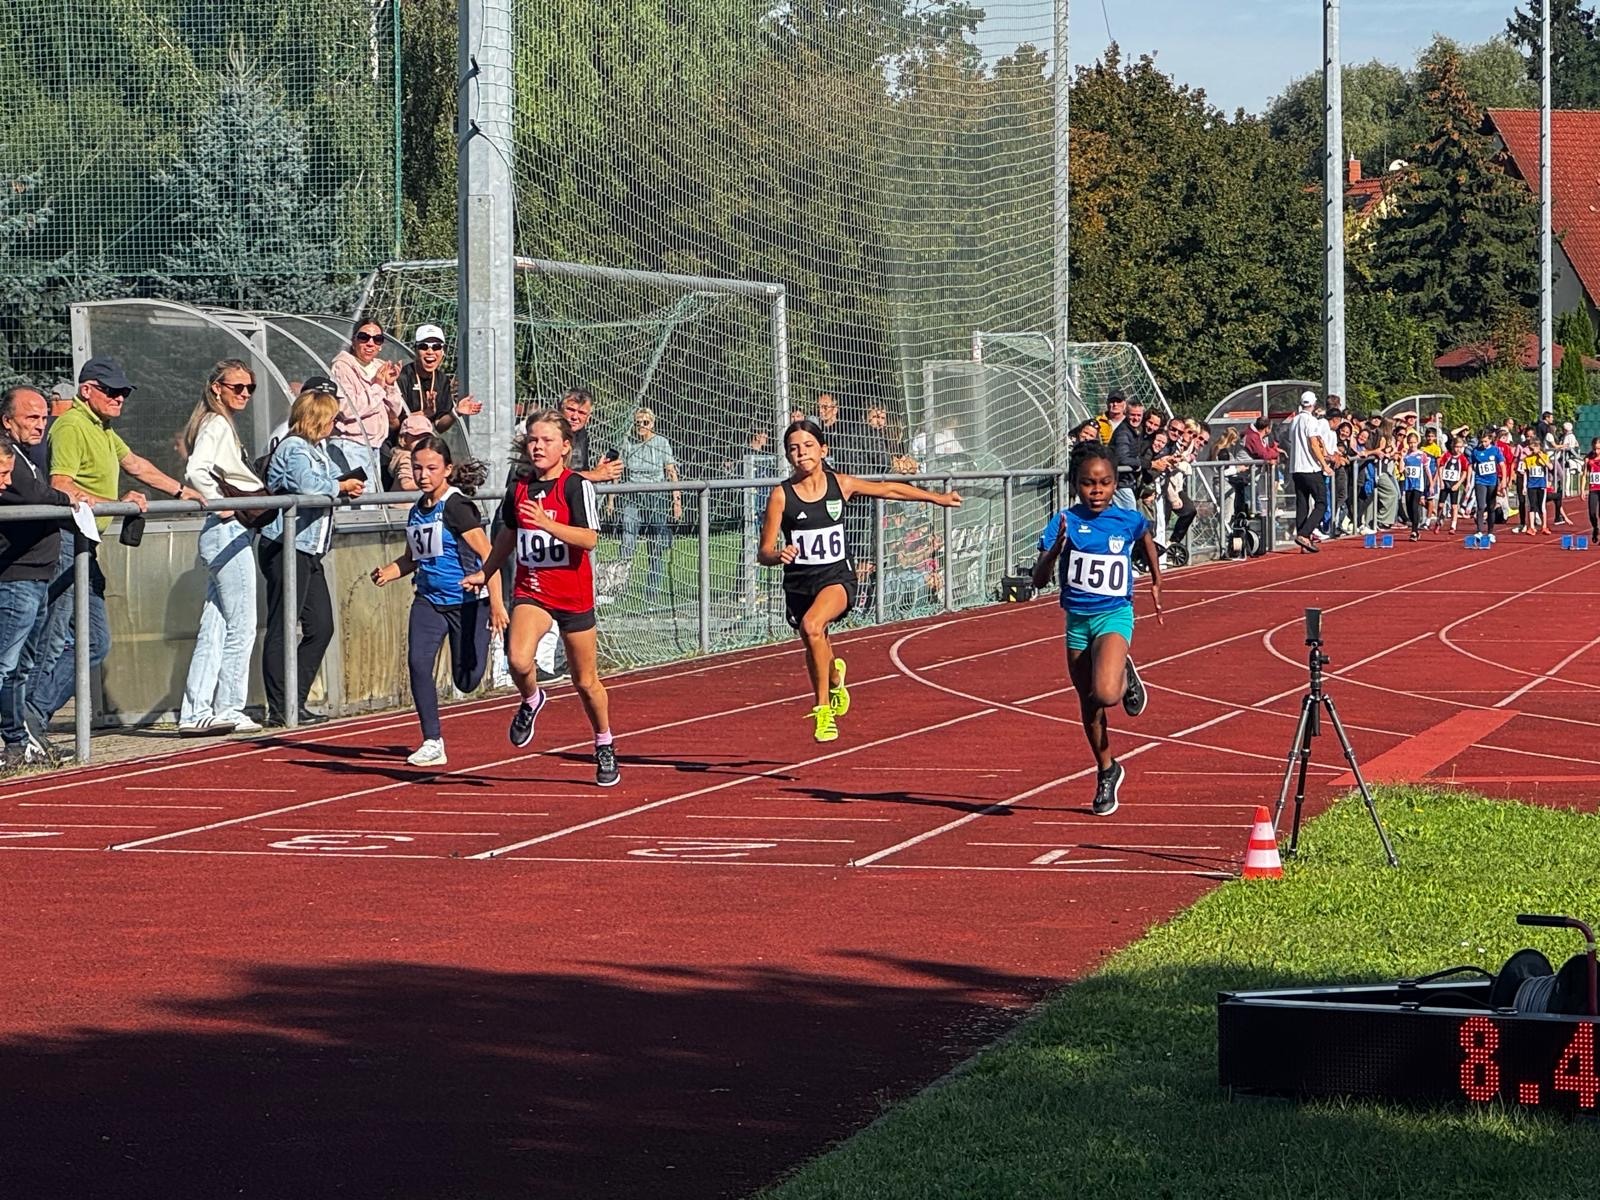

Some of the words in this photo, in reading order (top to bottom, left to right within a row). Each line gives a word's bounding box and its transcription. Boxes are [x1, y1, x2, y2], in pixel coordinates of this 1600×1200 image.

[1444, 471, 1455, 479] 52
[1479, 463, 1495, 474] 163
[413, 527, 434, 555] 37
[520, 533, 566, 563] 196
[796, 531, 842, 560] 146
[1071, 557, 1125, 591] 150
[1459, 1016, 1600, 1108] 8.4
